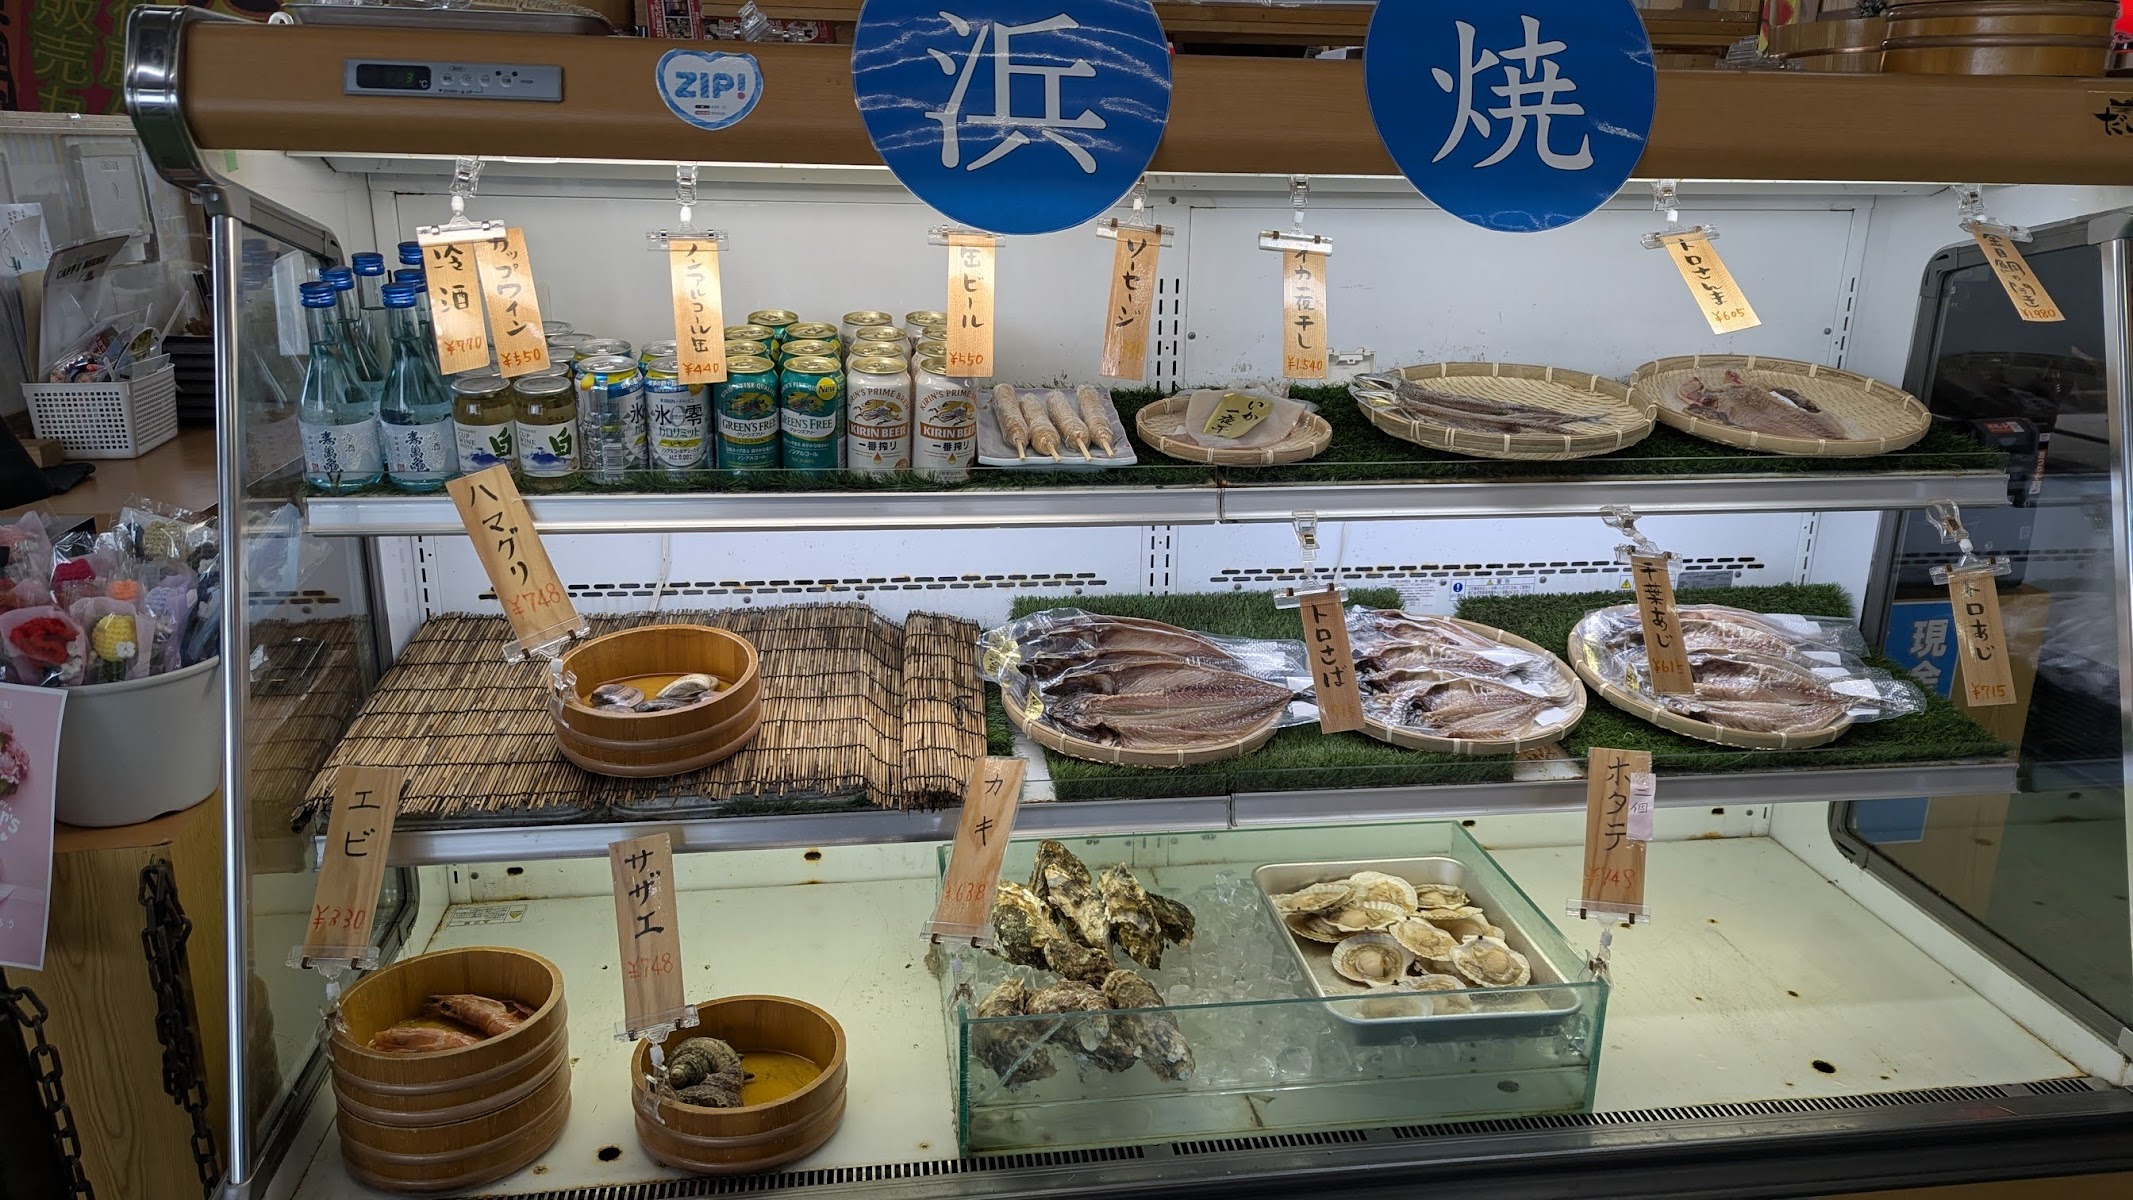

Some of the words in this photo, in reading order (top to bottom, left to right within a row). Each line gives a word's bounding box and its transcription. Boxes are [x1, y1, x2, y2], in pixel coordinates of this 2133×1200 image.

[406, 72, 414, 83] 3
[674, 71, 746, 100] ZIP!
[925, 11, 1107, 175] 浜
[1430, 13, 1596, 171] 焼
[433, 244, 470, 313] 冷酒
[1115, 238, 1147, 328] ソーセージ
[1678, 238, 1728, 306] トロさんま
[487, 237, 528, 337] カップワイン
[685, 243, 712, 353] ノンアルコール缶
[960, 247, 985, 329] 缶ビール
[1711, 307, 1746, 322] ¥605
[443, 335, 483, 356] ¥770
[500, 348, 542, 368] ¥550
[682, 362, 719, 376] ¥440
[949, 351, 984, 366] ¥550
[818, 385, 836, 394] New
[867, 388, 896, 397] PRIME
[920, 389, 944, 411] KIRIN'S
[946, 388, 971, 397] PRIME
[458, 431, 470, 439] CUP
[519, 431, 530, 439] CUP
[658, 426, 700, 438] カロリミット
[722, 418, 757, 433] GREEN'S
[759, 418, 777, 432] FREE
[809, 418, 833, 430] FREE
[850, 424, 880, 438] KIRIN
[881, 425, 906, 438] BEER
[923, 425, 956, 438] KIRIN
[460, 437, 476, 446] WINE
[520, 437, 537, 446] WINE
[858, 441, 898, 451] 一番搾り
[932, 441, 970, 451] 一番搾り
[470, 484, 529, 587] ハマグリ
[508, 582, 561, 620] ¥748
[1640, 561, 1673, 648] 千葉あじ
[1963, 581, 1994, 660] トロあじ
[1311, 604, 1347, 688] トロさば
[1651, 657, 1685, 675] ¥615
[1971, 681, 2006, 700] ¥715
[974, 773, 1004, 847] カキ
[1605, 756, 1631, 852] ホタテ
[344, 790, 381, 858] エビ
[624, 849, 665, 940] サザエ
[312, 904, 366, 931] ¥330
[626, 952, 674, 981] ¥748
